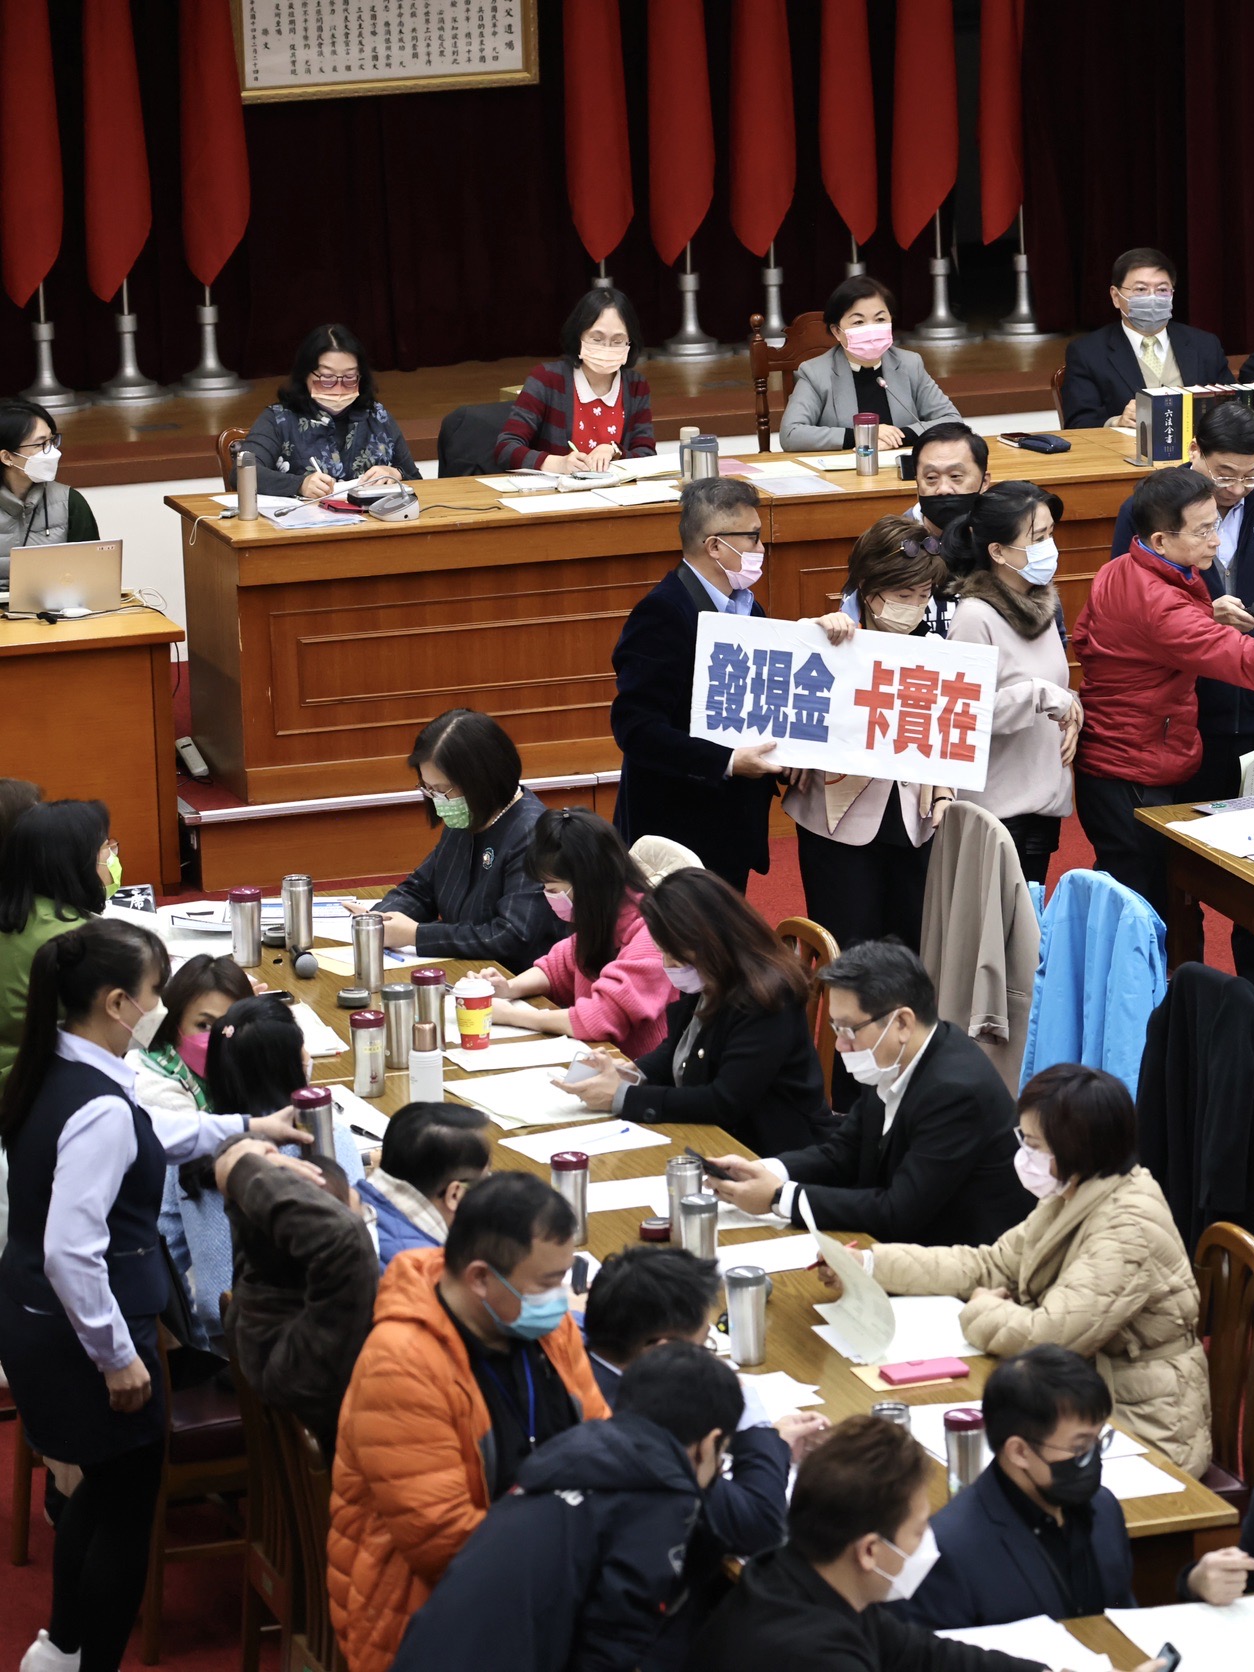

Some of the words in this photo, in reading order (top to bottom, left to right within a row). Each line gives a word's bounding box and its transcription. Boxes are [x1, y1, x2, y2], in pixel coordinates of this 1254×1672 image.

[1164, 409, 1175, 444] 六法全書
[705, 641, 835, 743] 發現金
[853, 660, 982, 763] 卡實在
